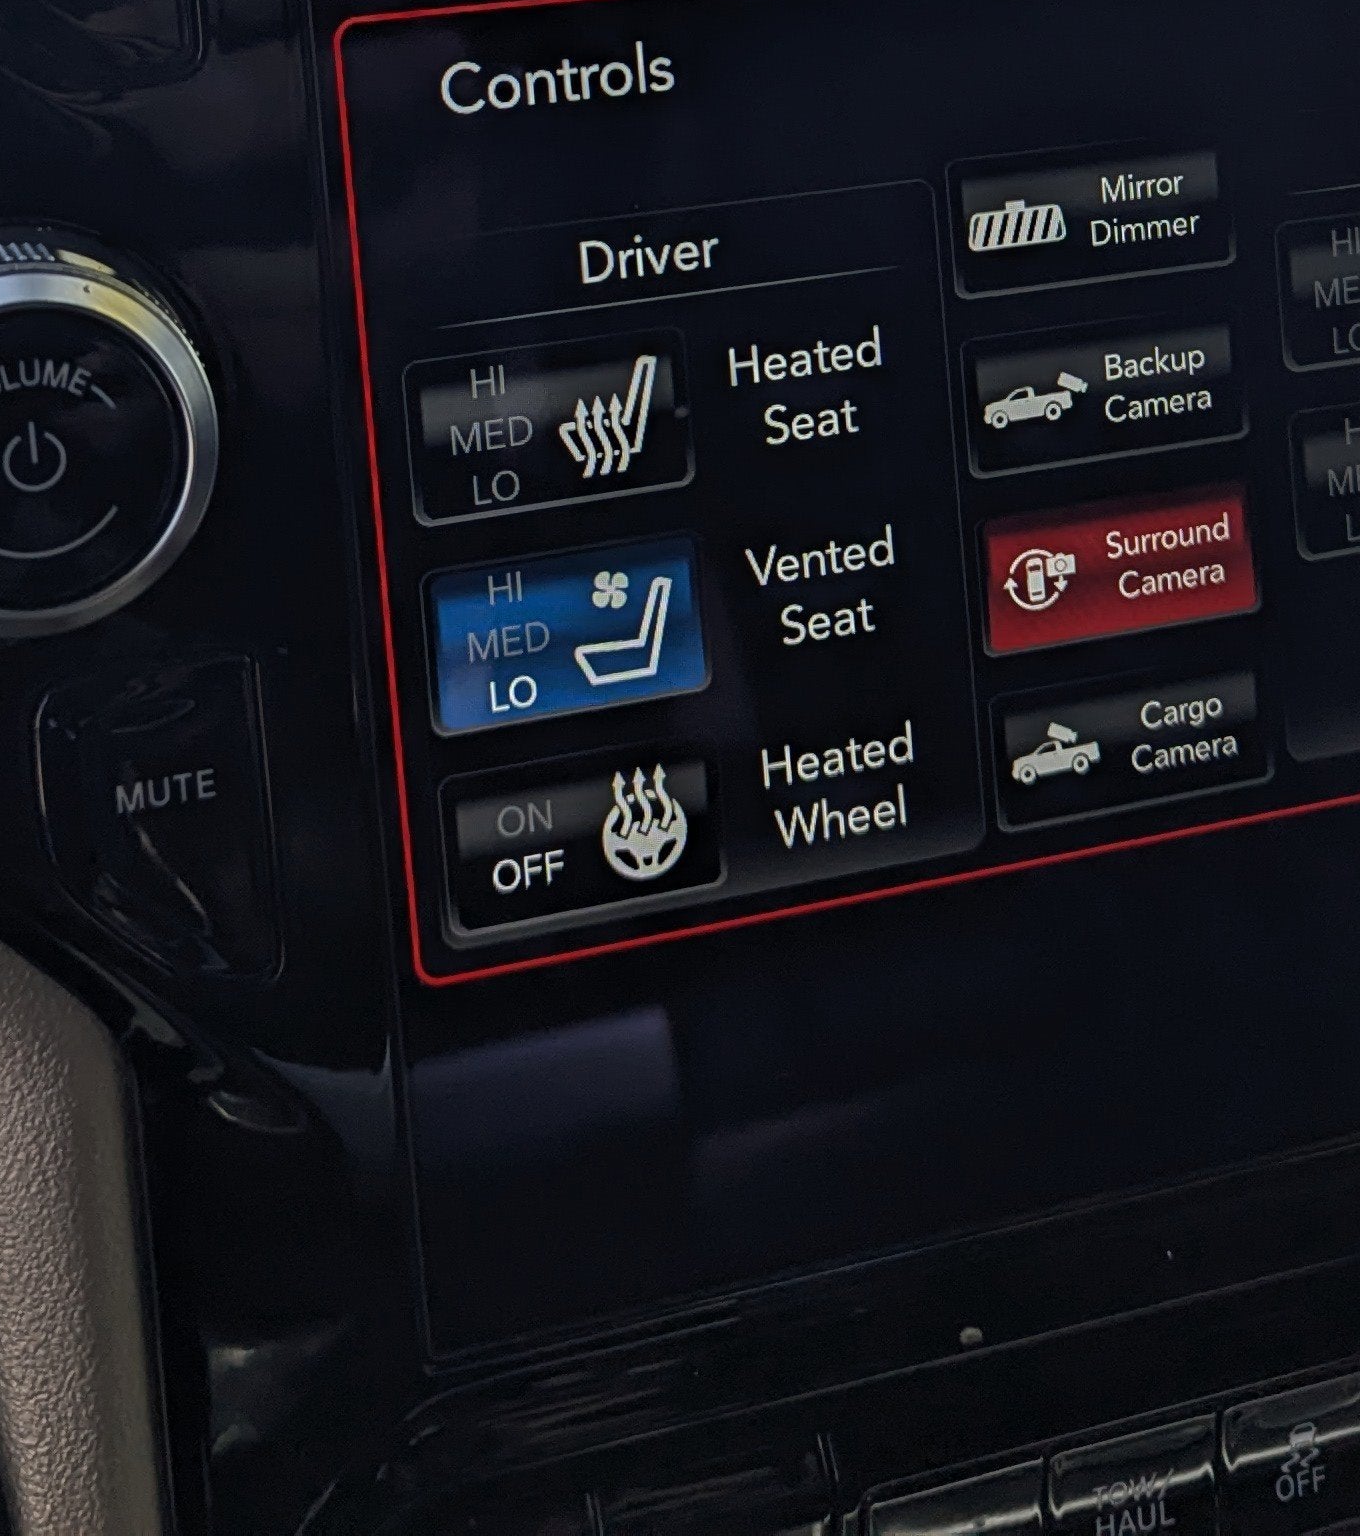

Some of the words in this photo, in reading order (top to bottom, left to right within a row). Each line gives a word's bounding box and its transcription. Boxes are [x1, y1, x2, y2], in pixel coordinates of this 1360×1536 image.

[440, 41, 676, 116] Controls
[1101, 174, 1184, 205] Mirror
[1090, 213, 1200, 248] Dimmer
[579, 234, 720, 286] Driver
[728, 324, 883, 387] Heated
[1103, 346, 1206, 382] Backup
[470, 364, 505, 399] HI
[763, 399, 860, 446] Seat
[1104, 388, 1213, 424] Camera
[449, 415, 533, 456] MED
[473, 470, 520, 506] LO
[744, 523, 895, 586] Vented
[1106, 512, 1231, 560] Surround
[487, 570, 523, 606] HI
[1118, 561, 1226, 600] Camera
[467, 621, 550, 664] MED
[780, 598, 876, 646] Seat
[489, 675, 538, 714] LO
[1140, 696, 1224, 732] Cargo
[761, 719, 914, 790] Heated
[1131, 734, 1239, 775] Camera
[115, 768, 217, 815] MUTE
[497, 798, 553, 838] ON
[773, 783, 907, 850] Wheel
[492, 848, 565, 895] OFF
[1275, 1465, 1328, 1503] OFF
[1095, 1498, 1176, 1536] HAUL
